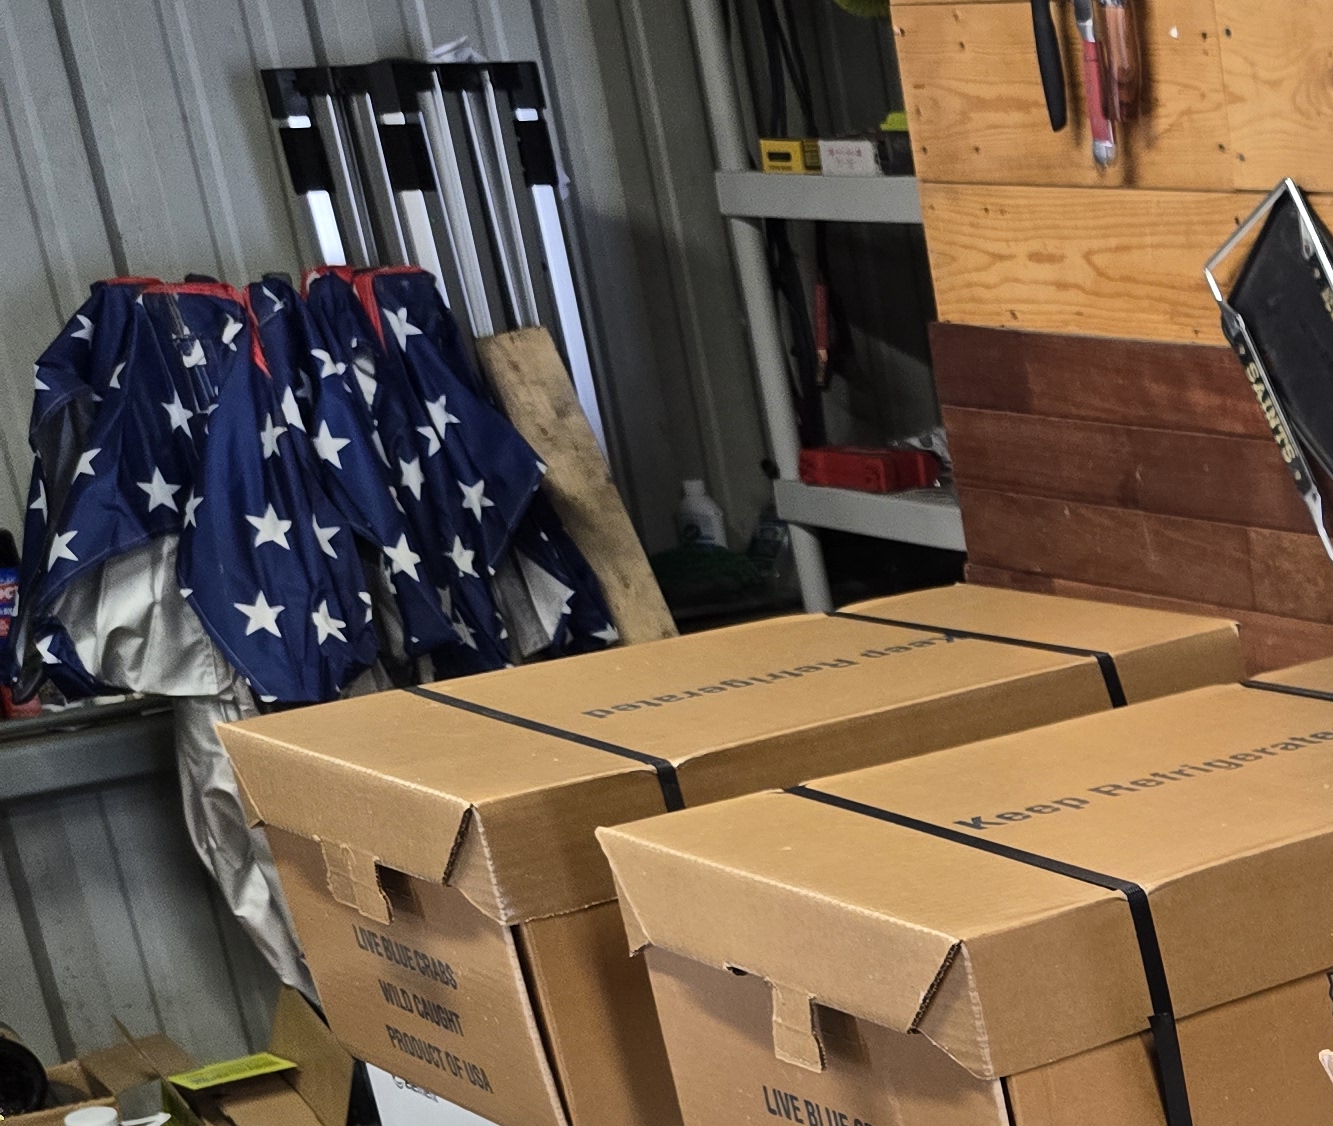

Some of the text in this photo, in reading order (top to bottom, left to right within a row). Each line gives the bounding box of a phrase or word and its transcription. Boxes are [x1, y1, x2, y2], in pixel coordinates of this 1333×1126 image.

[1245, 361, 1296, 463] SAINTS
[581, 658, 861, 719] Refrigerated
[953, 796, 1091, 831] Keep
[352, 923, 458, 990] LIVE BLUE CRABS
[378, 979, 464, 1037] WILD CAUGHT
[385, 1024, 447, 1072] PRODUCT
[446, 1055, 464, 1079] OF
[464, 1063, 494, 1095] USA
[762, 1085, 805, 1125] LIVE
